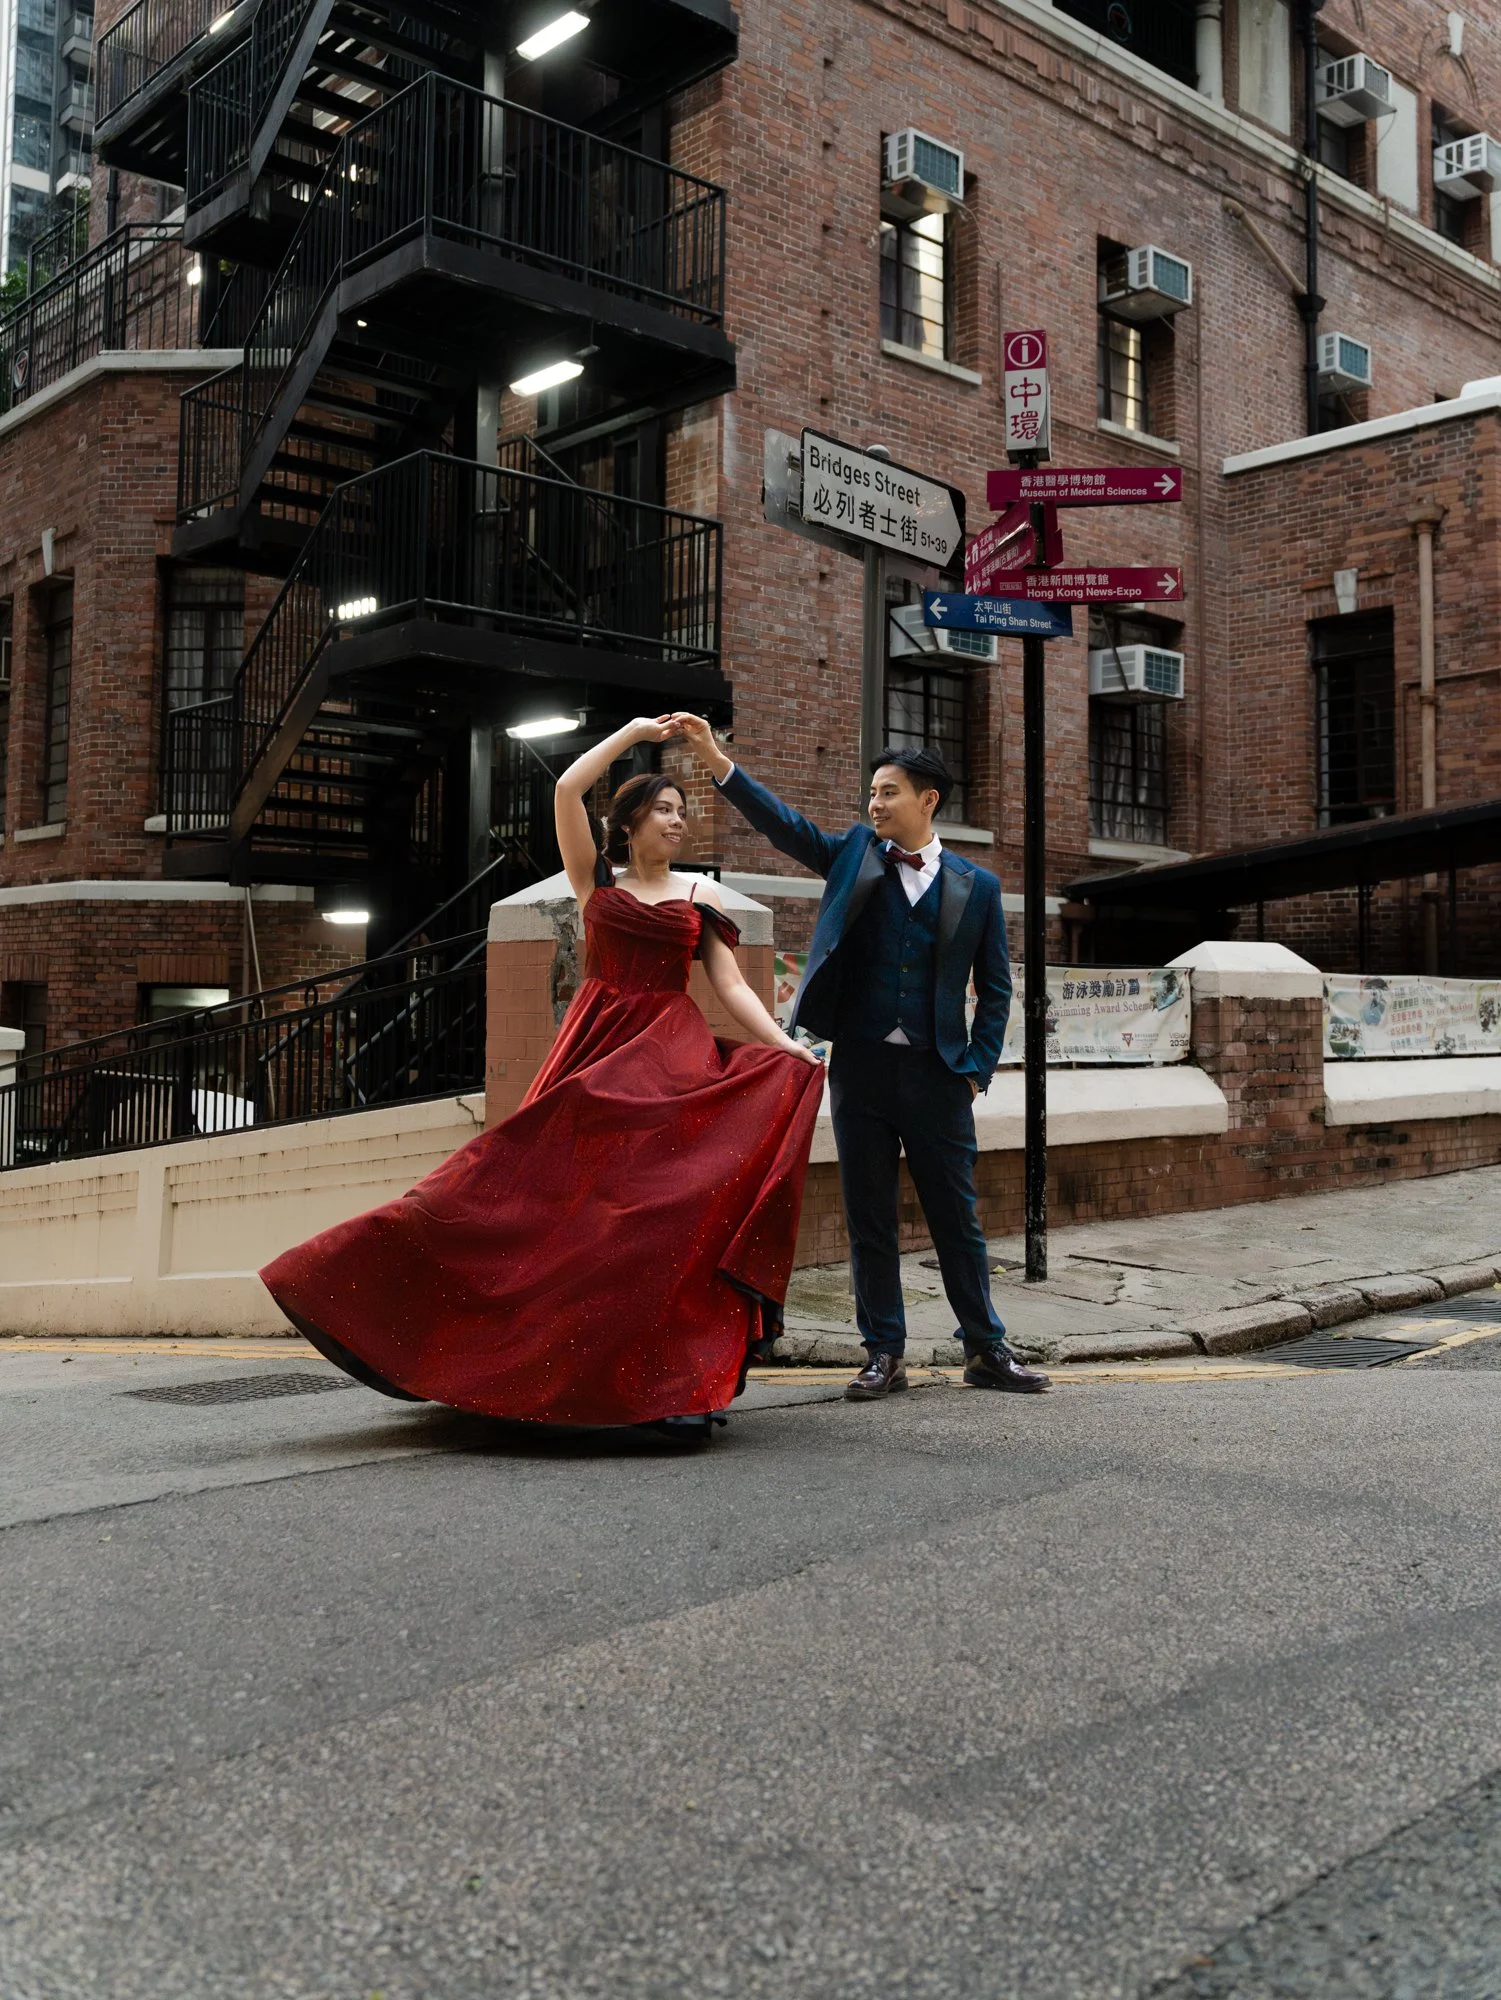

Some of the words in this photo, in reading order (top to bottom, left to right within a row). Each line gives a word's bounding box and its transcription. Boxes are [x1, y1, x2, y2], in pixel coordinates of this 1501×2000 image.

[1010, 377, 1042, 440] 中環
[810, 445, 871, 487] Bridges
[874, 471, 921, 507] Street
[1020, 474, 1106, 488] 香港醫學博物館
[1019, 488, 1057, 498] Museum
[1059, 487, 1069, 497] of
[1070, 487, 1105, 497] Medical
[1106, 486, 1148, 496] Sciences
[813, 484, 918, 546] 必列者士街
[920, 532, 948, 554] 51-39
[1026, 574, 1109, 587] 香港新聞博覽館
[1027, 588, 1054, 599] Hong
[1056, 588, 1084, 599] Kong
[1086, 587, 1142, 598] News-Expo
[974, 601, 1012, 615] 太平山街
[974, 613, 987, 624] Tai
[988, 615, 1007, 627] Ping
[1008, 616, 1028, 627] Shan
[1029, 619, 1052, 629] Street
[1062, 978, 1140, 1000] 游泳獎勵計劃
[1047, 1003, 1091, 1018] Swimming
[1094, 1002, 1120, 1015] Award
[1123, 1000, 1154, 1013] Scheme
